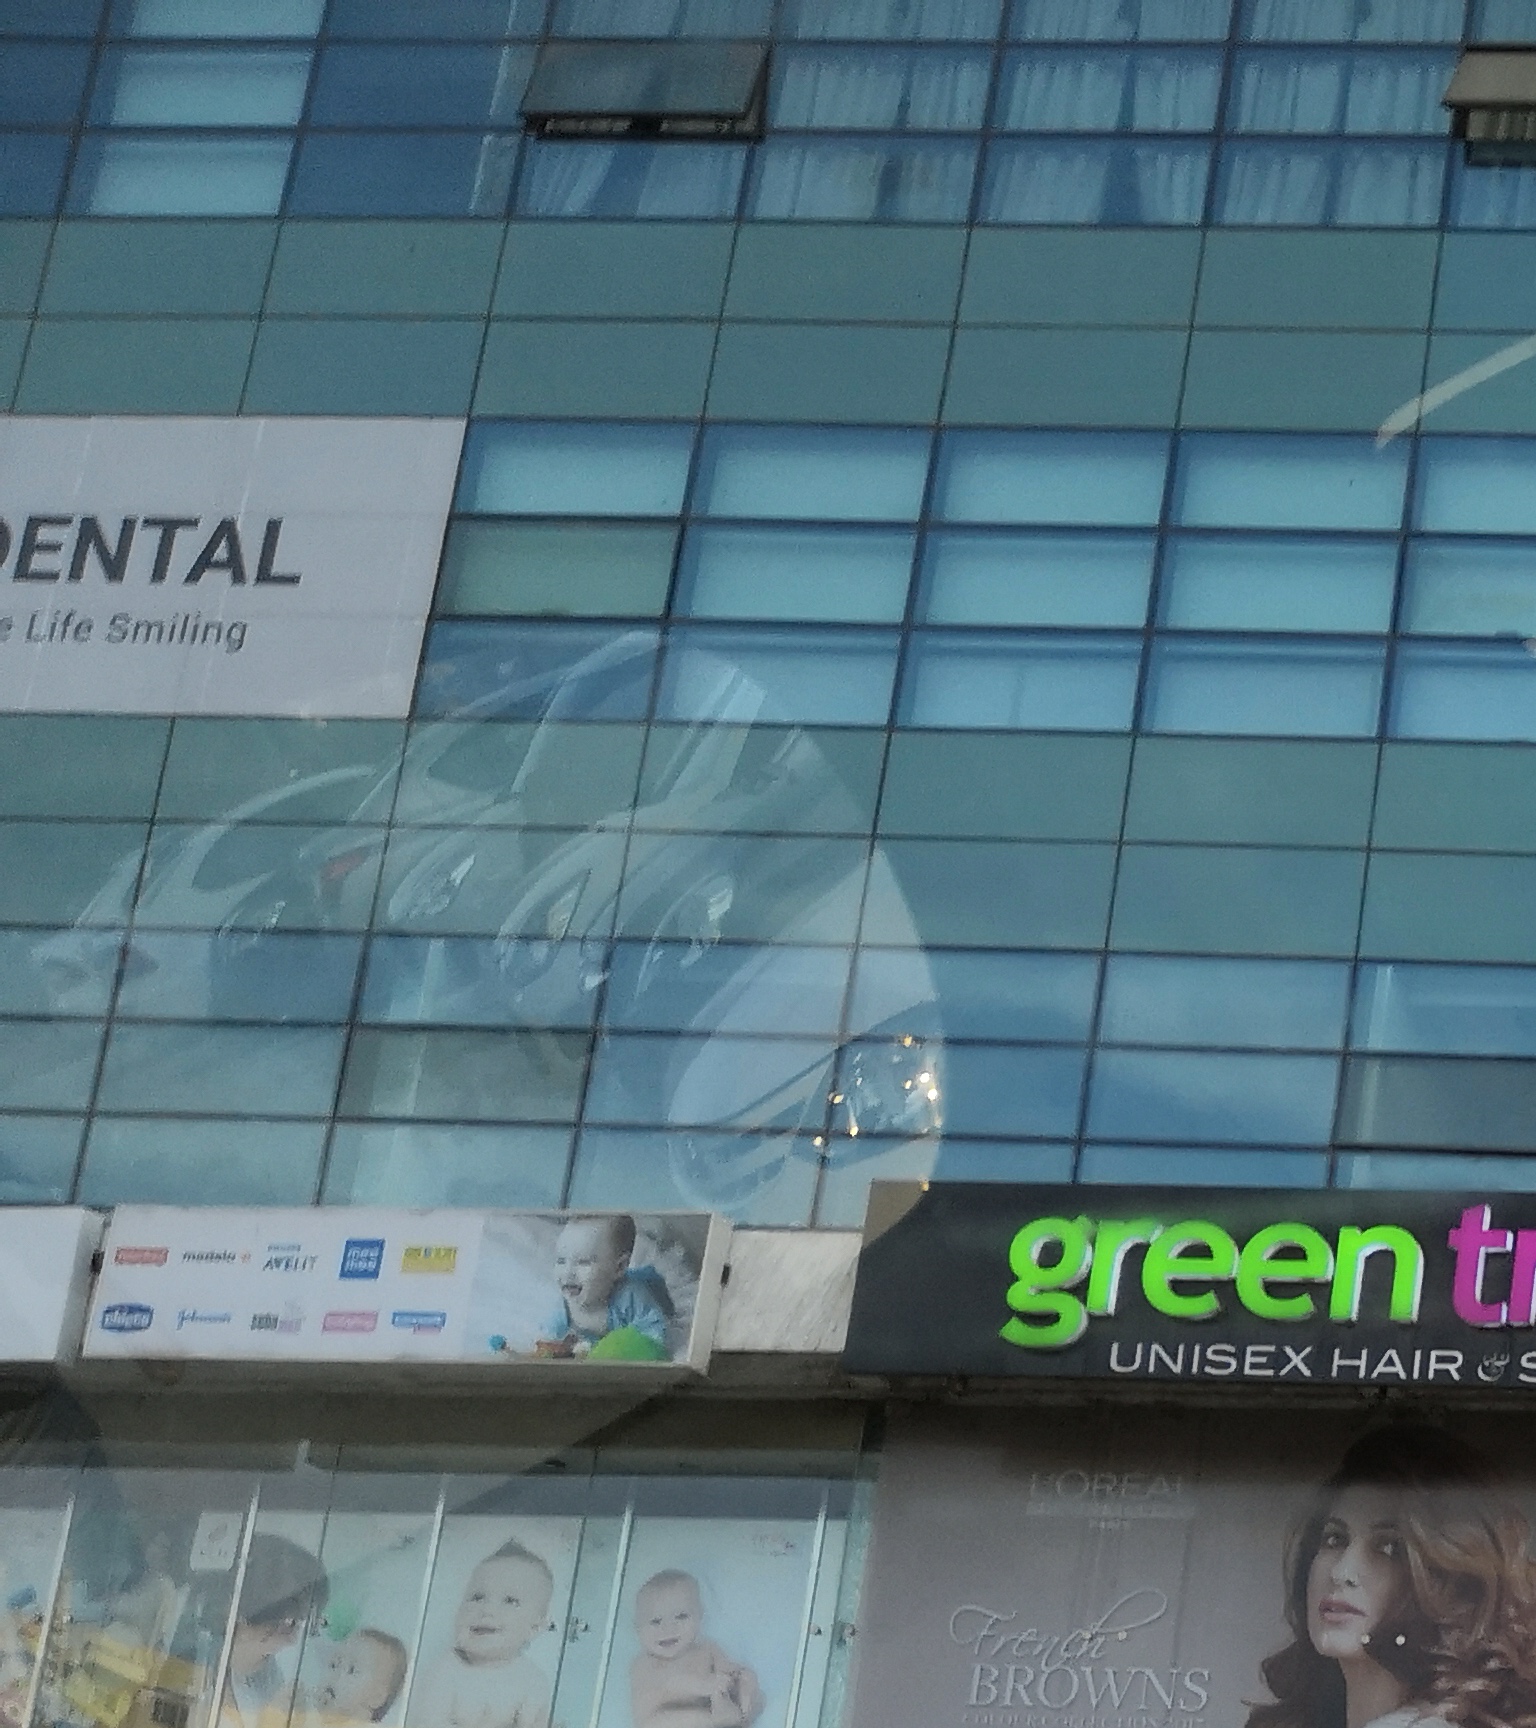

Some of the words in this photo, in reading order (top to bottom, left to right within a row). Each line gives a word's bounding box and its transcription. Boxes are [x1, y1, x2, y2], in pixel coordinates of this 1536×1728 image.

[0, 514, 303, 586] ENTAL
[25, 608, 94, 644] Life
[105, 610, 248, 655] Smiling
[999, 1212, 1424, 1349] green
[1108, 1341, 1314, 1379] UNISEX
[1328, 1347, 1465, 1384] HAIR
[950, 1589, 1168, 1671] French
[968, 1662, 1212, 1714] BROWNS
